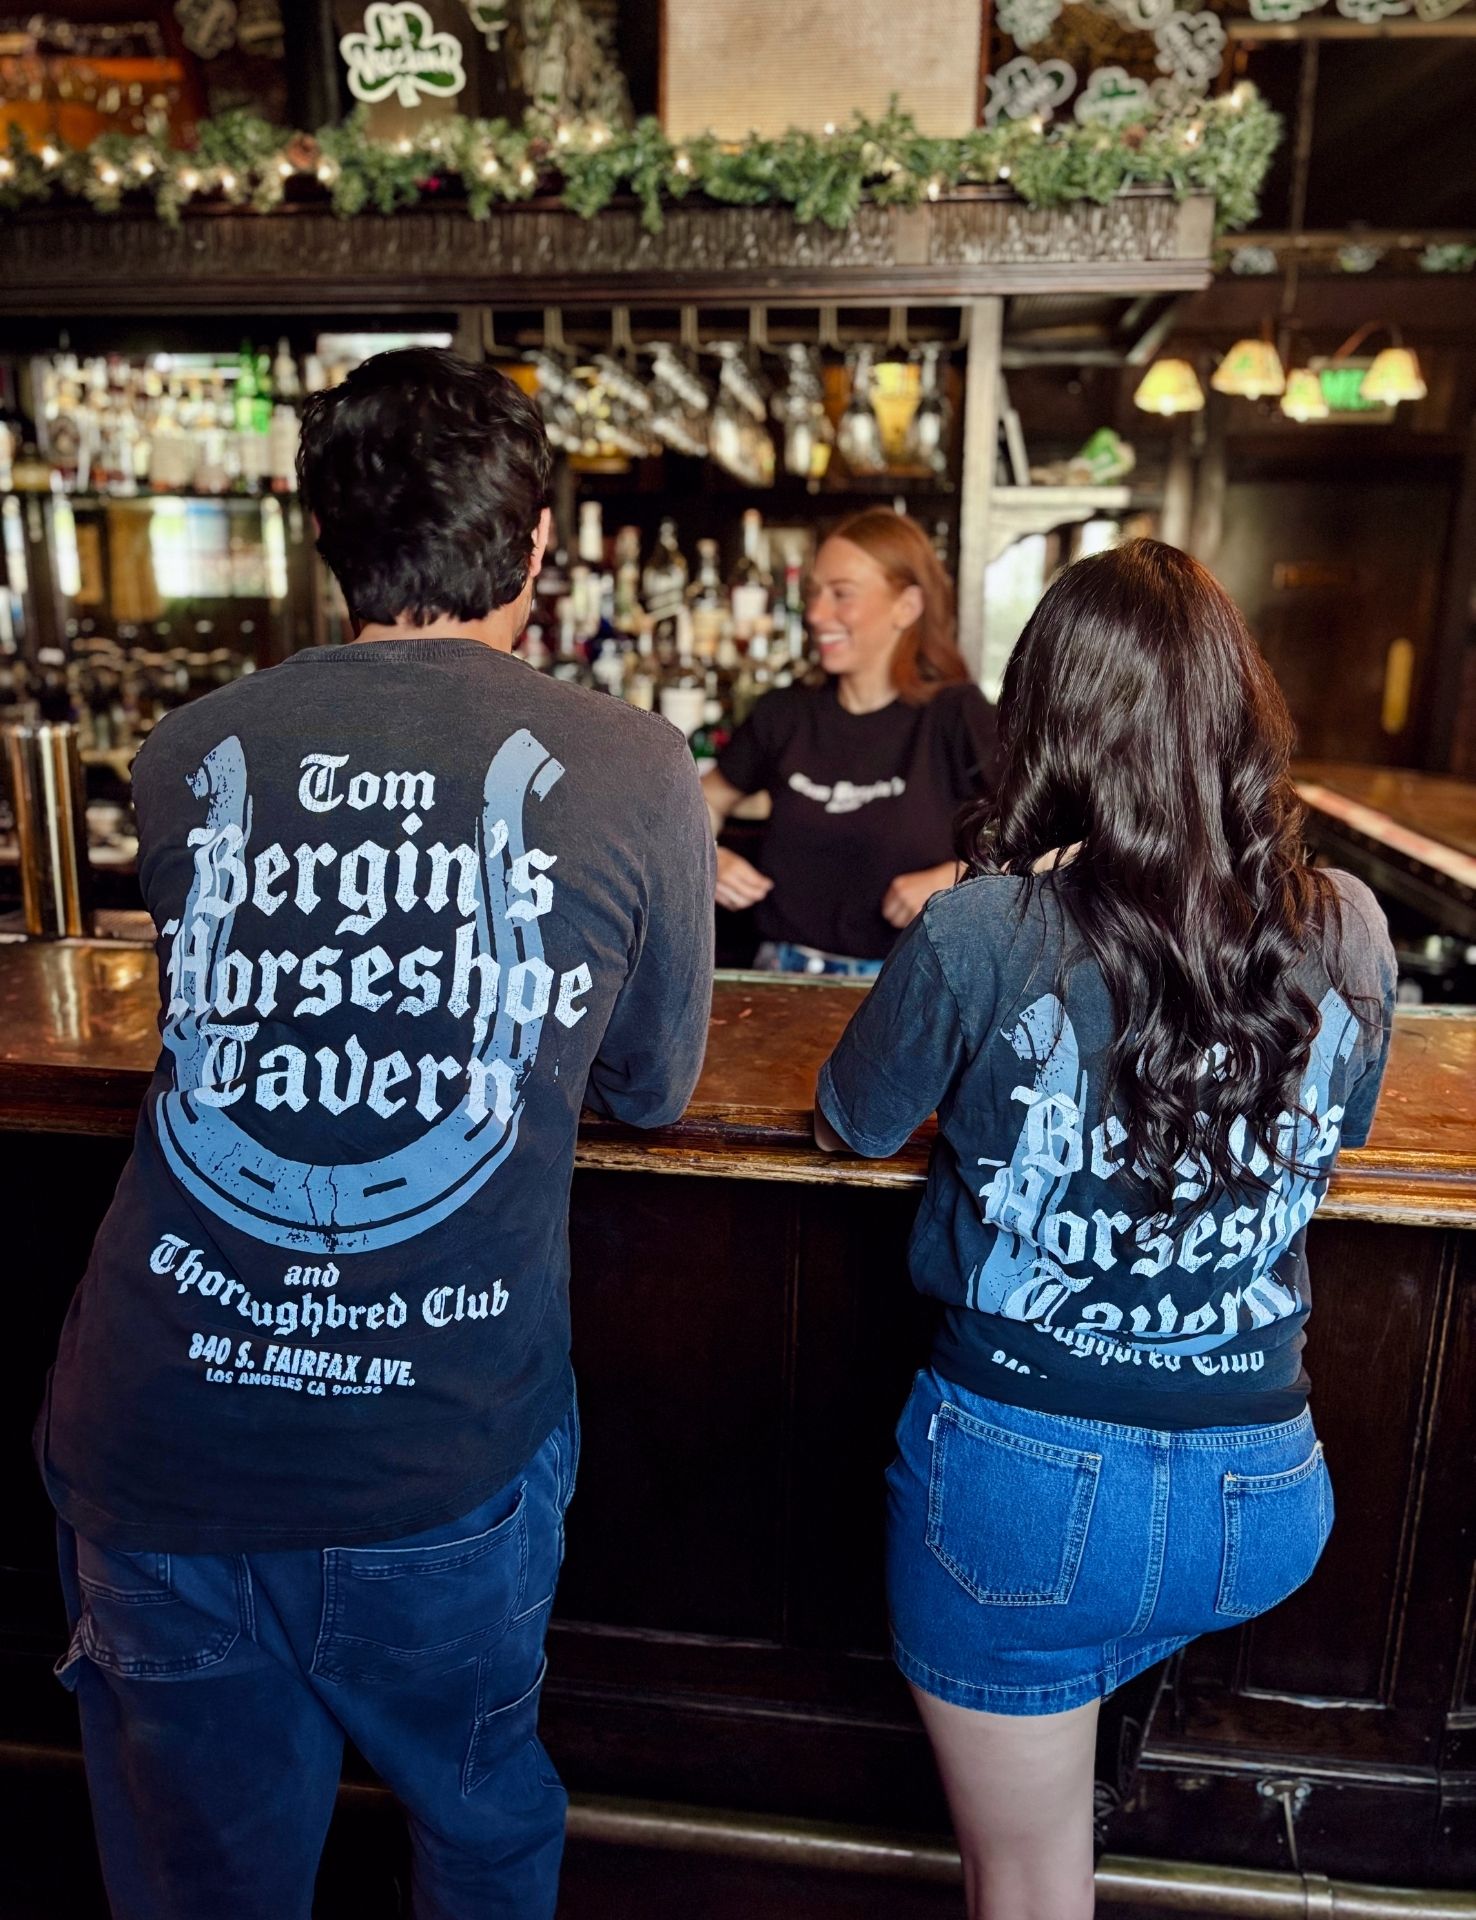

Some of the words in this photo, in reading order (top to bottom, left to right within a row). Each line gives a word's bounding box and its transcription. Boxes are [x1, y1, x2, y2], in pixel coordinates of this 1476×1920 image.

[299, 753, 435, 812] Tom
[187, 813, 558, 935] Bergin's
[162, 918, 594, 1043] Horseshoe
[194, 1021, 515, 1125] Tavern
[283, 1262, 341, 1288] and
[421, 1278, 510, 1328] Club
[188, 1332, 232, 1366] 840
[234, 1341, 256, 1370] S.
[262, 1344, 362, 1383] FAIRFAX
[364, 1357, 417, 1387] AVE.
[206, 1368, 235, 1384] LOS
[238, 1372, 304, 1392] ANGELES
[306, 1380, 327, 1397] CA
[331, 1385, 384, 1397] 90036
